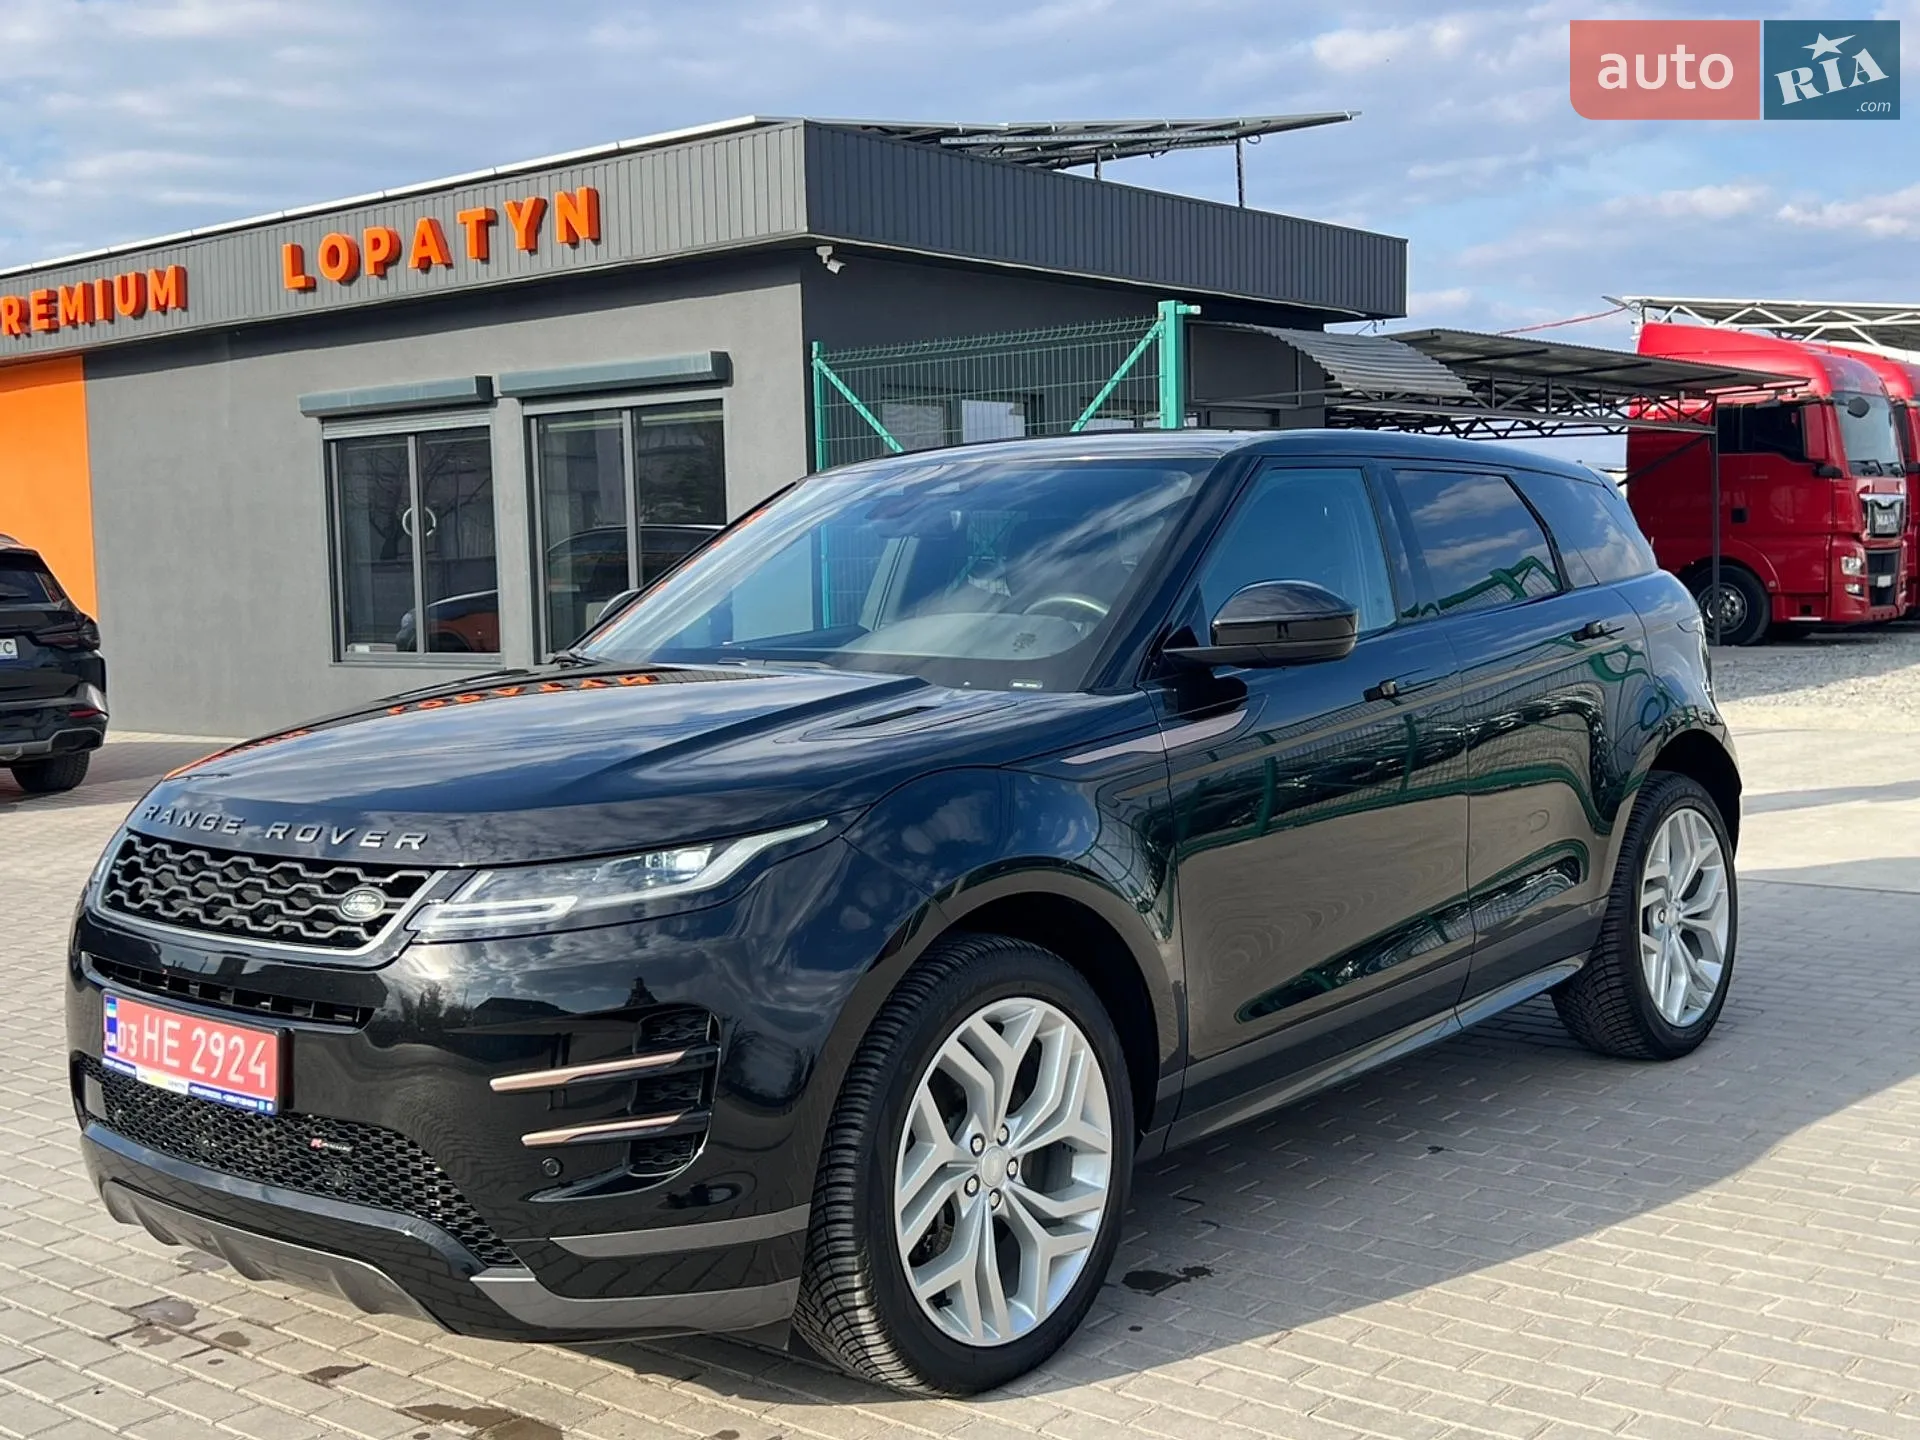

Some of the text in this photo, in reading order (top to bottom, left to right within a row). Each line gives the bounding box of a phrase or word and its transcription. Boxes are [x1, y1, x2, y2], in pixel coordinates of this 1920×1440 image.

[0, 186, 600, 337] REMIUM LOPATYN
[144, 804, 428, 851] RANGE ROVER
[190, 1026, 267, 1089] 2924
